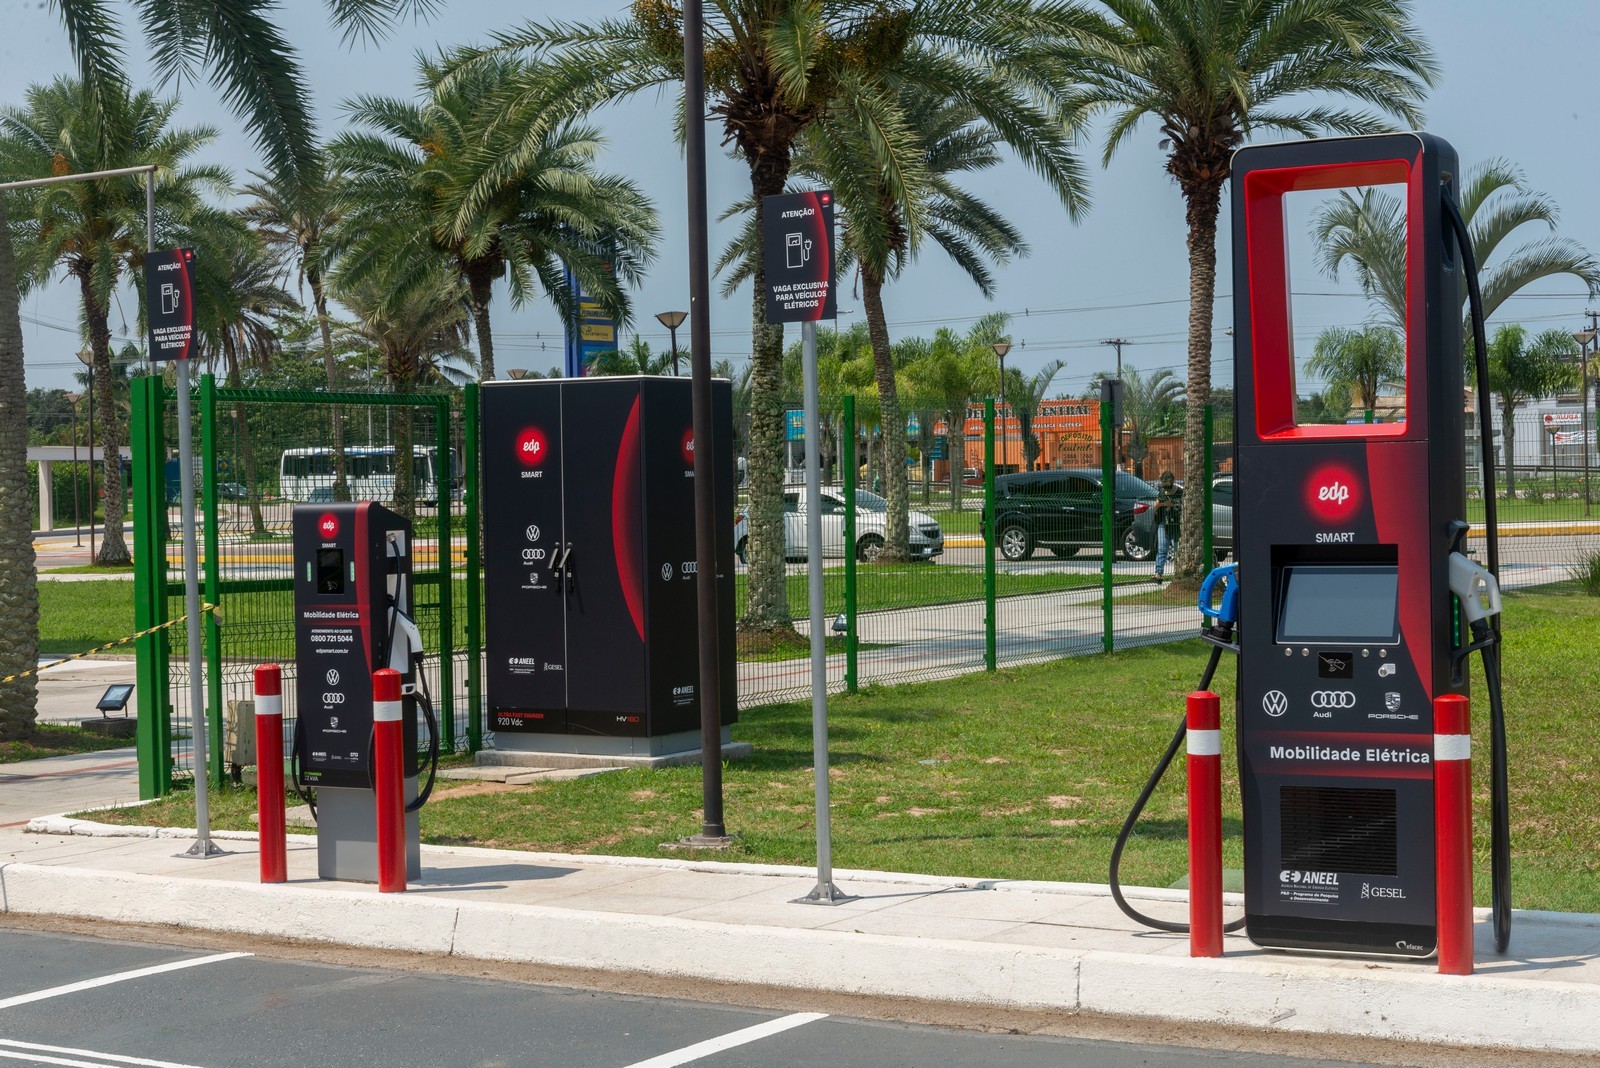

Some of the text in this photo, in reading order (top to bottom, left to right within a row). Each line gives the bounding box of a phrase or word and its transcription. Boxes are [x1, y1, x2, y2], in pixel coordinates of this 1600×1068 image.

[781, 208, 815, 218] ATENÇÃO!
[158, 262, 181, 271] ATENÇÃO!
[773, 281, 829, 293] VAGA EXCLUSIVA
[775, 290, 827, 301] PARA VEÍCULOS
[784, 299, 819, 309] ELÉTRICOS
[153, 325, 193, 335] VAGA EXCLUSIVA
[168, 332, 191, 341] VEÍCULOS
[160, 341, 186, 349] ELÉTRICOS
[523, 439, 540, 454] edp
[684, 470, 695, 478] SMA
[1318, 482, 1349, 504] edp
[322, 520, 335, 531] edp
[1315, 532, 1355, 543] SMART
[304, 611, 359, 619] Mobilidade Elétrica
[519, 657, 535, 665] ANEEL
[498, 717, 523, 726] 920 Vdc
[1270, 746, 1430, 764] Mobilidade Elétrica
[1303, 872, 1339, 885] ANEEL
[1371, 887, 1406, 898] GESEL
